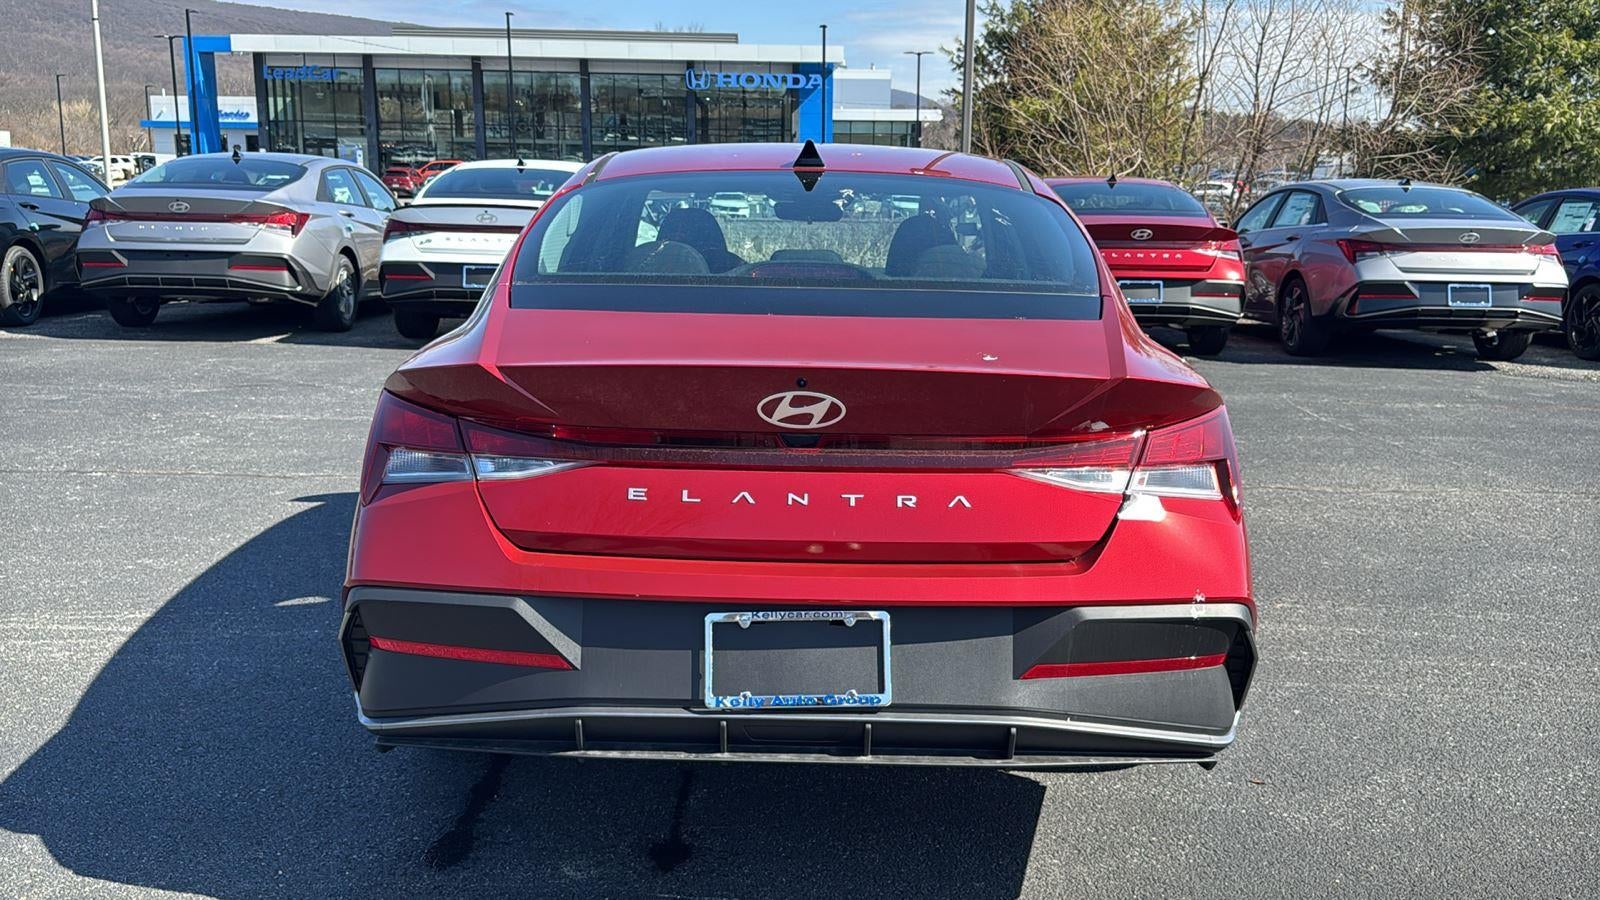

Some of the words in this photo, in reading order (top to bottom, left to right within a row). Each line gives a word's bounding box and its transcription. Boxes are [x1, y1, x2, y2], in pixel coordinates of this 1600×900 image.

[263, 64, 337, 80] LeadCar
[715, 72, 829, 89] HONDA
[627, 487, 972, 508] ELANTRA
[751, 610, 844, 620] Kellycar.com
[715, 696, 764, 708] Kelly
[771, 695, 818, 707] Auto
[824, 693, 882, 706] Group
